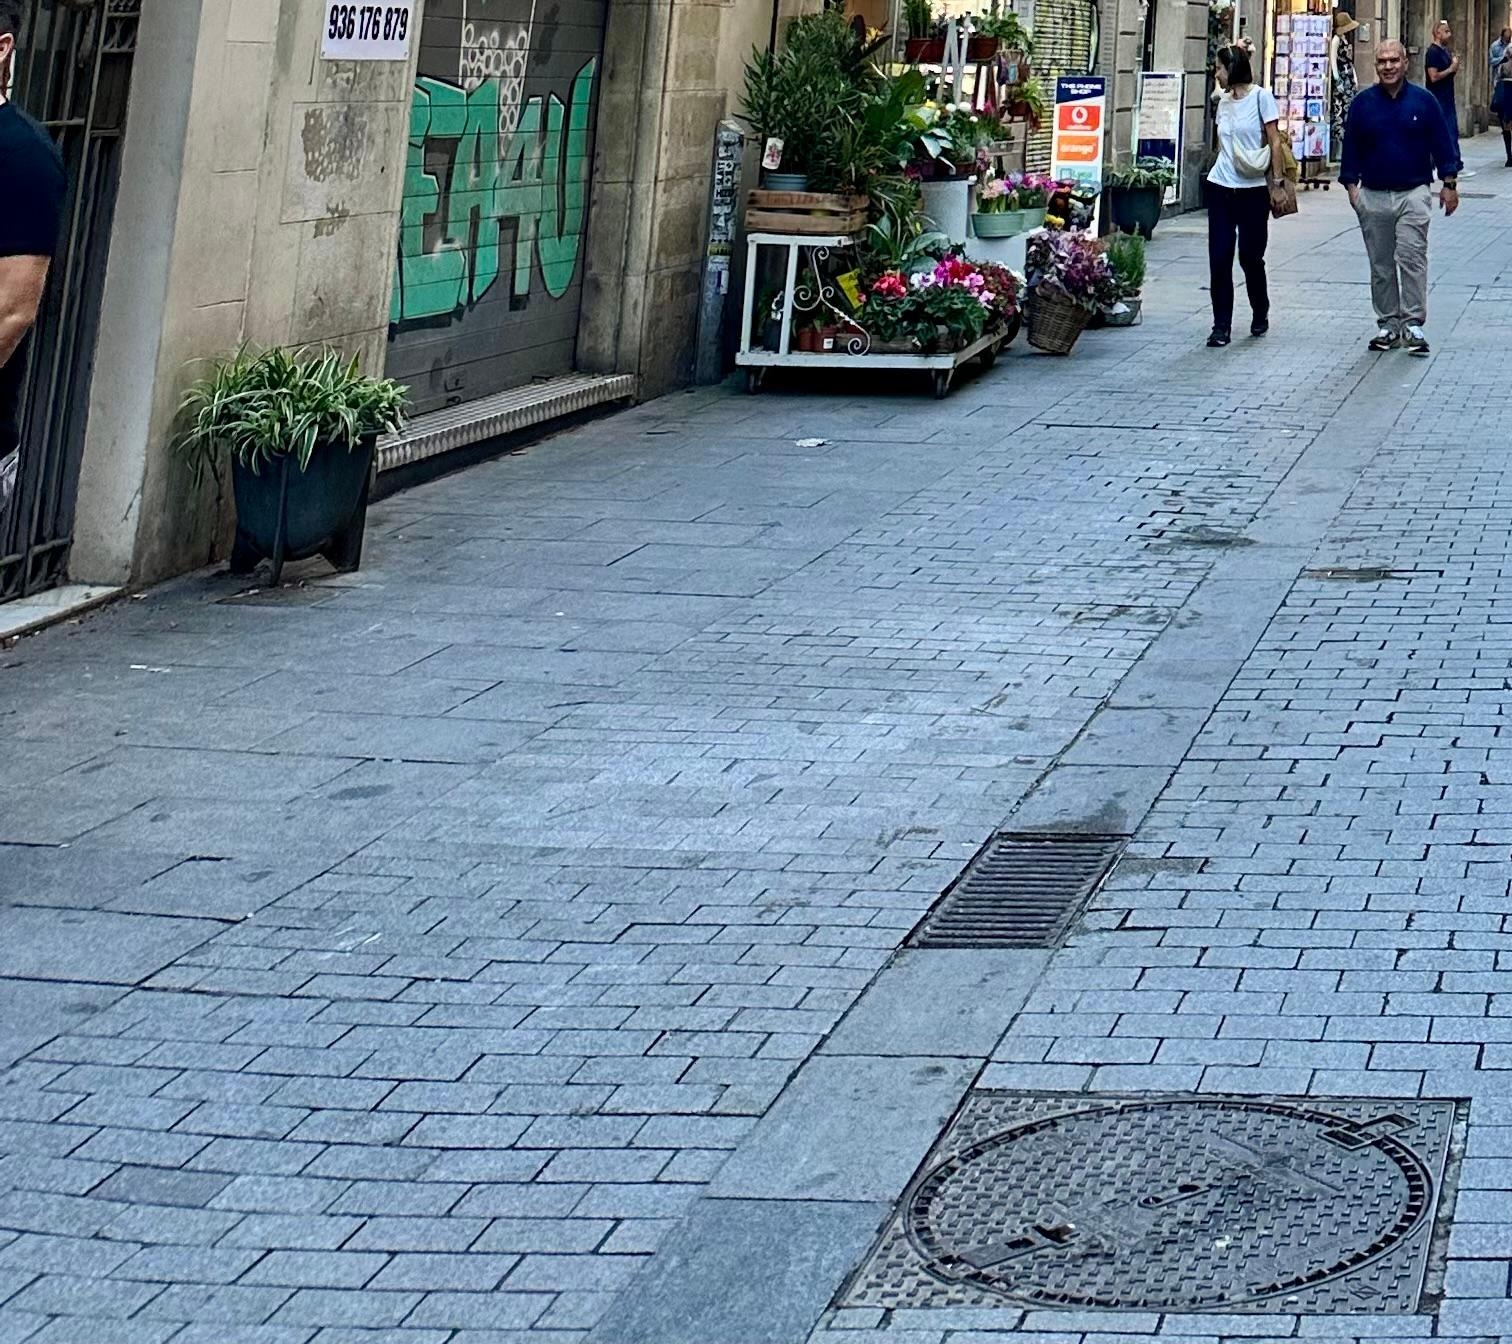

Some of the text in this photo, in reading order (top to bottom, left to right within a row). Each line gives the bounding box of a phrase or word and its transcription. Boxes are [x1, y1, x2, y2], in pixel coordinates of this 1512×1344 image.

[328, 5, 409, 41] 936 176 879
